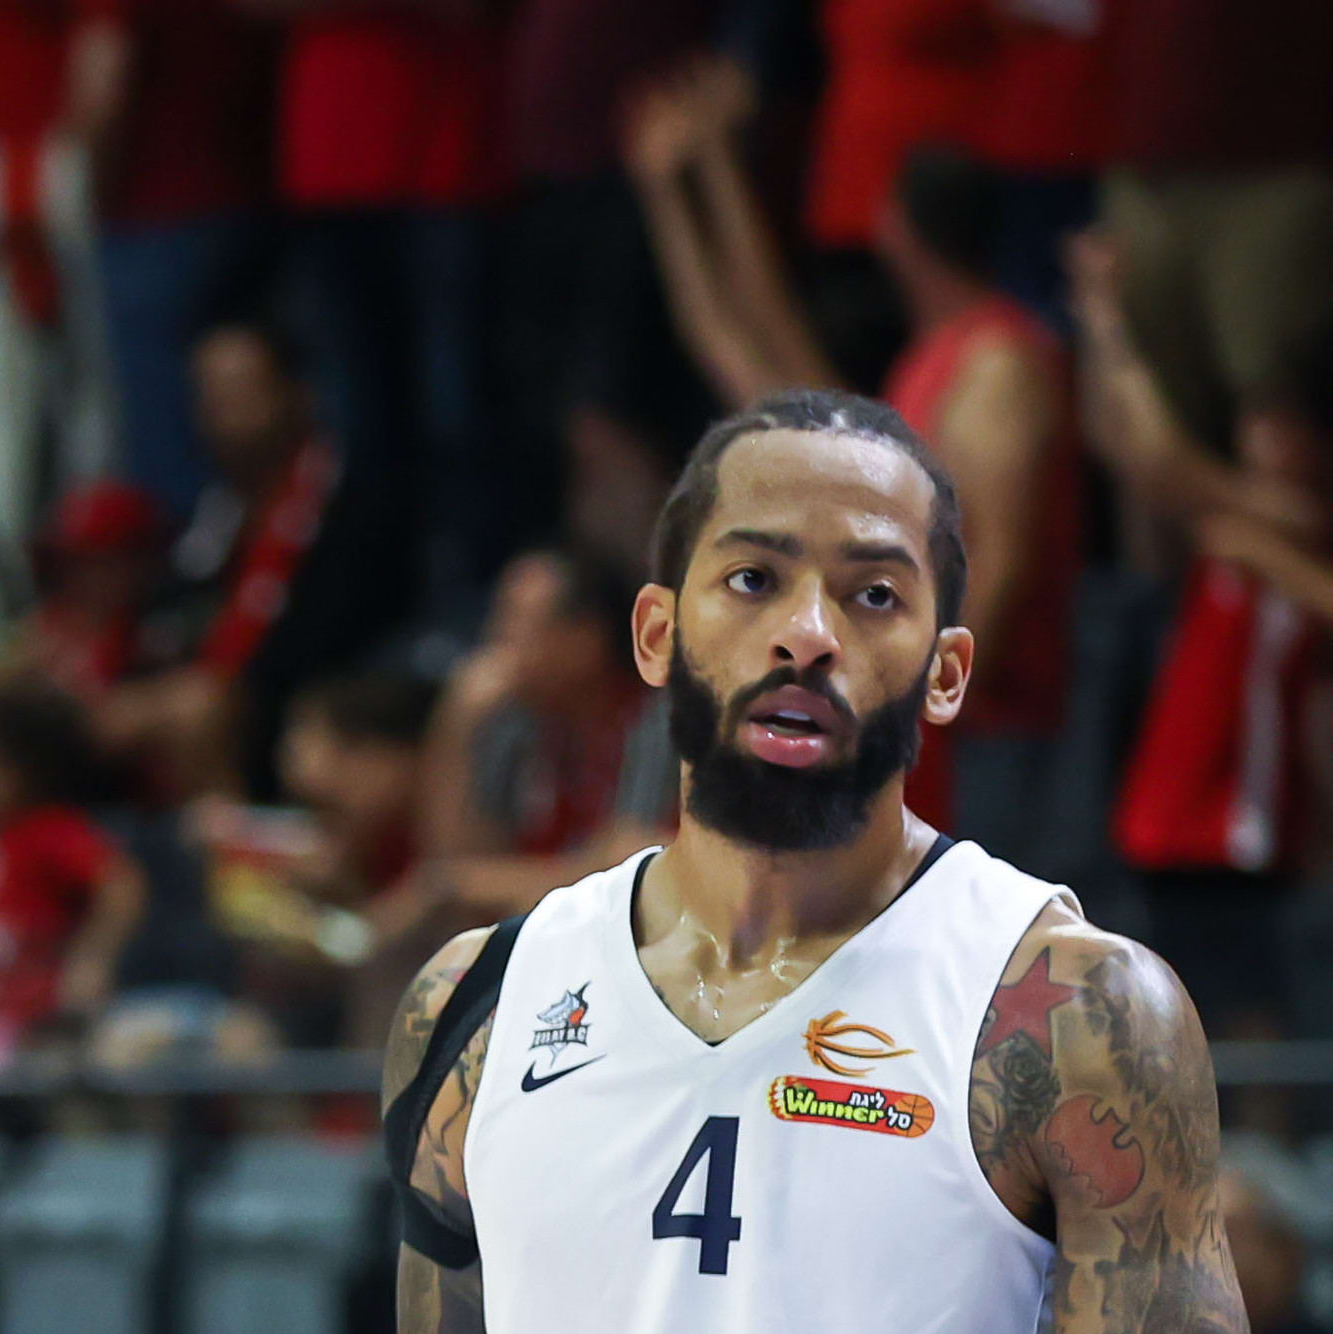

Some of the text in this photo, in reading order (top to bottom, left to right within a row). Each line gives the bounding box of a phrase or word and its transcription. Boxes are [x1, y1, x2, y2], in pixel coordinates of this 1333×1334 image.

[785, 1087, 885, 1124] Winner
[887, 1106, 912, 1129] סל
[652, 1115, 742, 1276] 4
